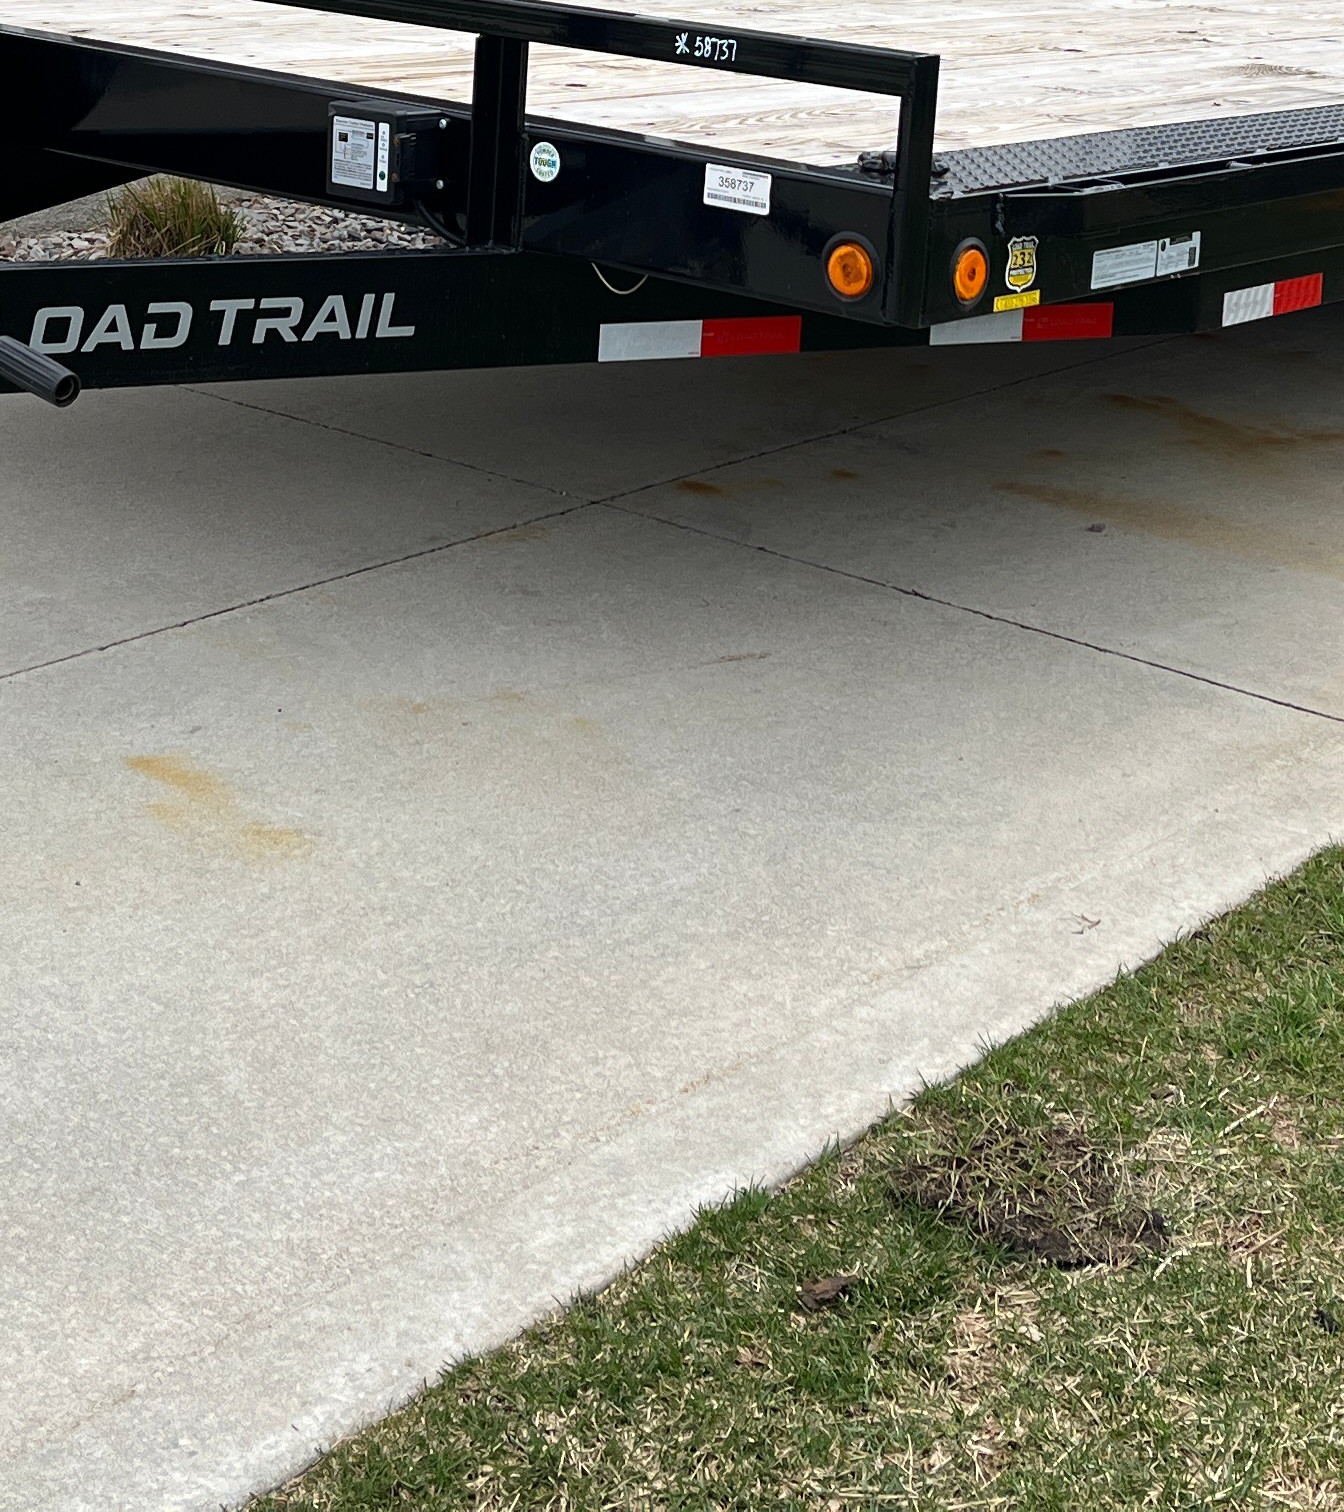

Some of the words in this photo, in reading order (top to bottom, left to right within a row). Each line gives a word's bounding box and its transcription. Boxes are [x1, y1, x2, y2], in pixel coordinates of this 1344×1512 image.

[694, 36, 737, 62] 58737
[718, 175, 755, 192] 358737
[210, 291, 416, 347] TRAIL
